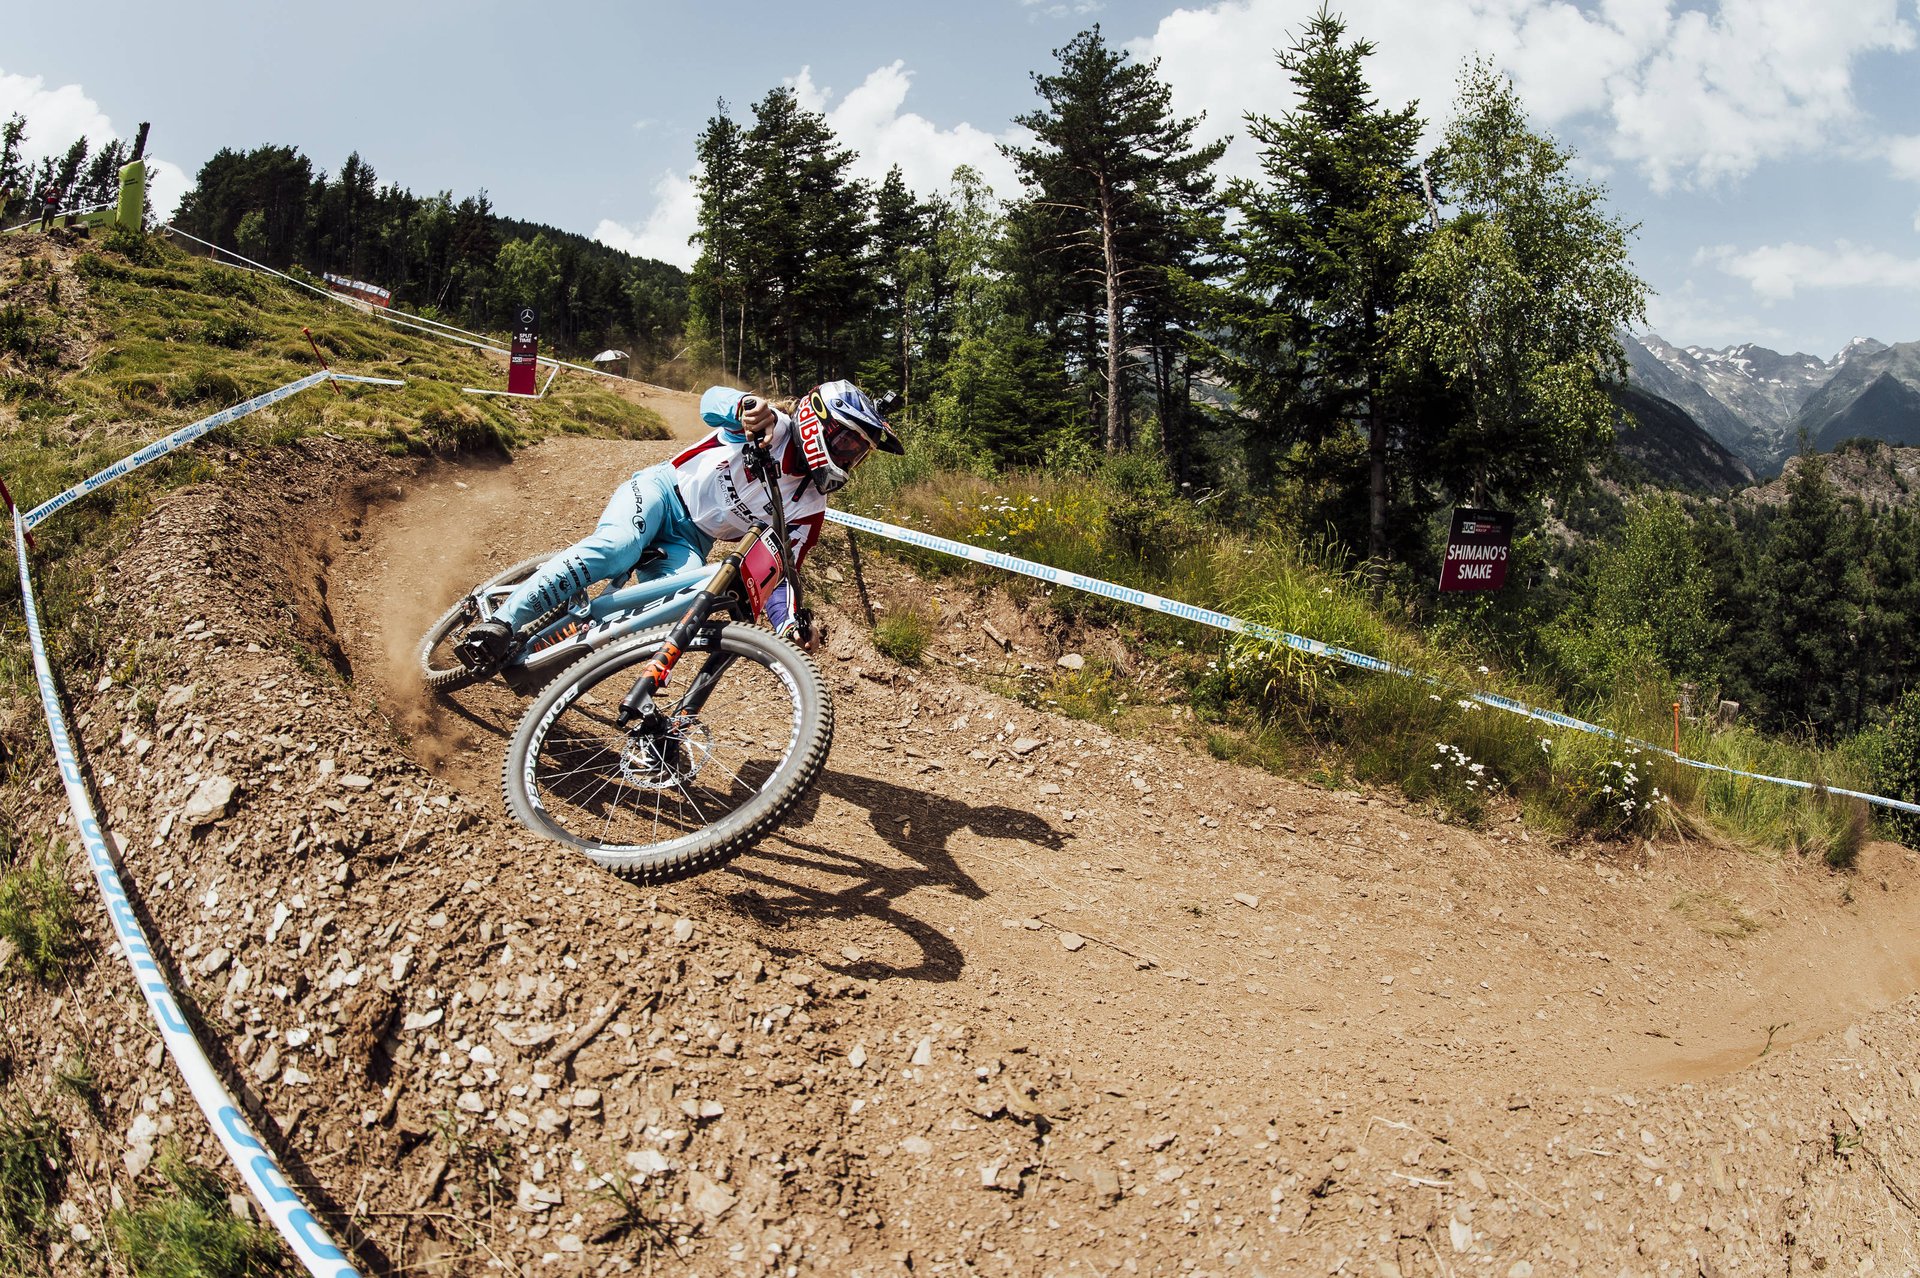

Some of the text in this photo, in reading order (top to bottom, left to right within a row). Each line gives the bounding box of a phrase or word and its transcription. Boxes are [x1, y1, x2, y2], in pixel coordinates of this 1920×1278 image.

[800, 420, 829, 470] Bull
[630, 480, 643, 515] ENDURA
[718, 475, 733, 507] FACTORY
[724, 469, 759, 522] TREK
[1463, 523, 1476, 532] UCI
[766, 539, 777, 554] UCI
[1447, 544, 1508, 561] SHIMANO'S
[575, 554, 592, 583] TREK
[760, 565, 777, 589] 1
[898, 527, 970, 557] SHIMANO
[983, 552, 1058, 580] SHIMANO
[1071, 576, 1145, 604] SHIMANO
[1159, 600, 1231, 628] SHIMANO
[1457, 564, 1493, 580] SNAKE
[524, 682, 580, 810] BONTRAGER
